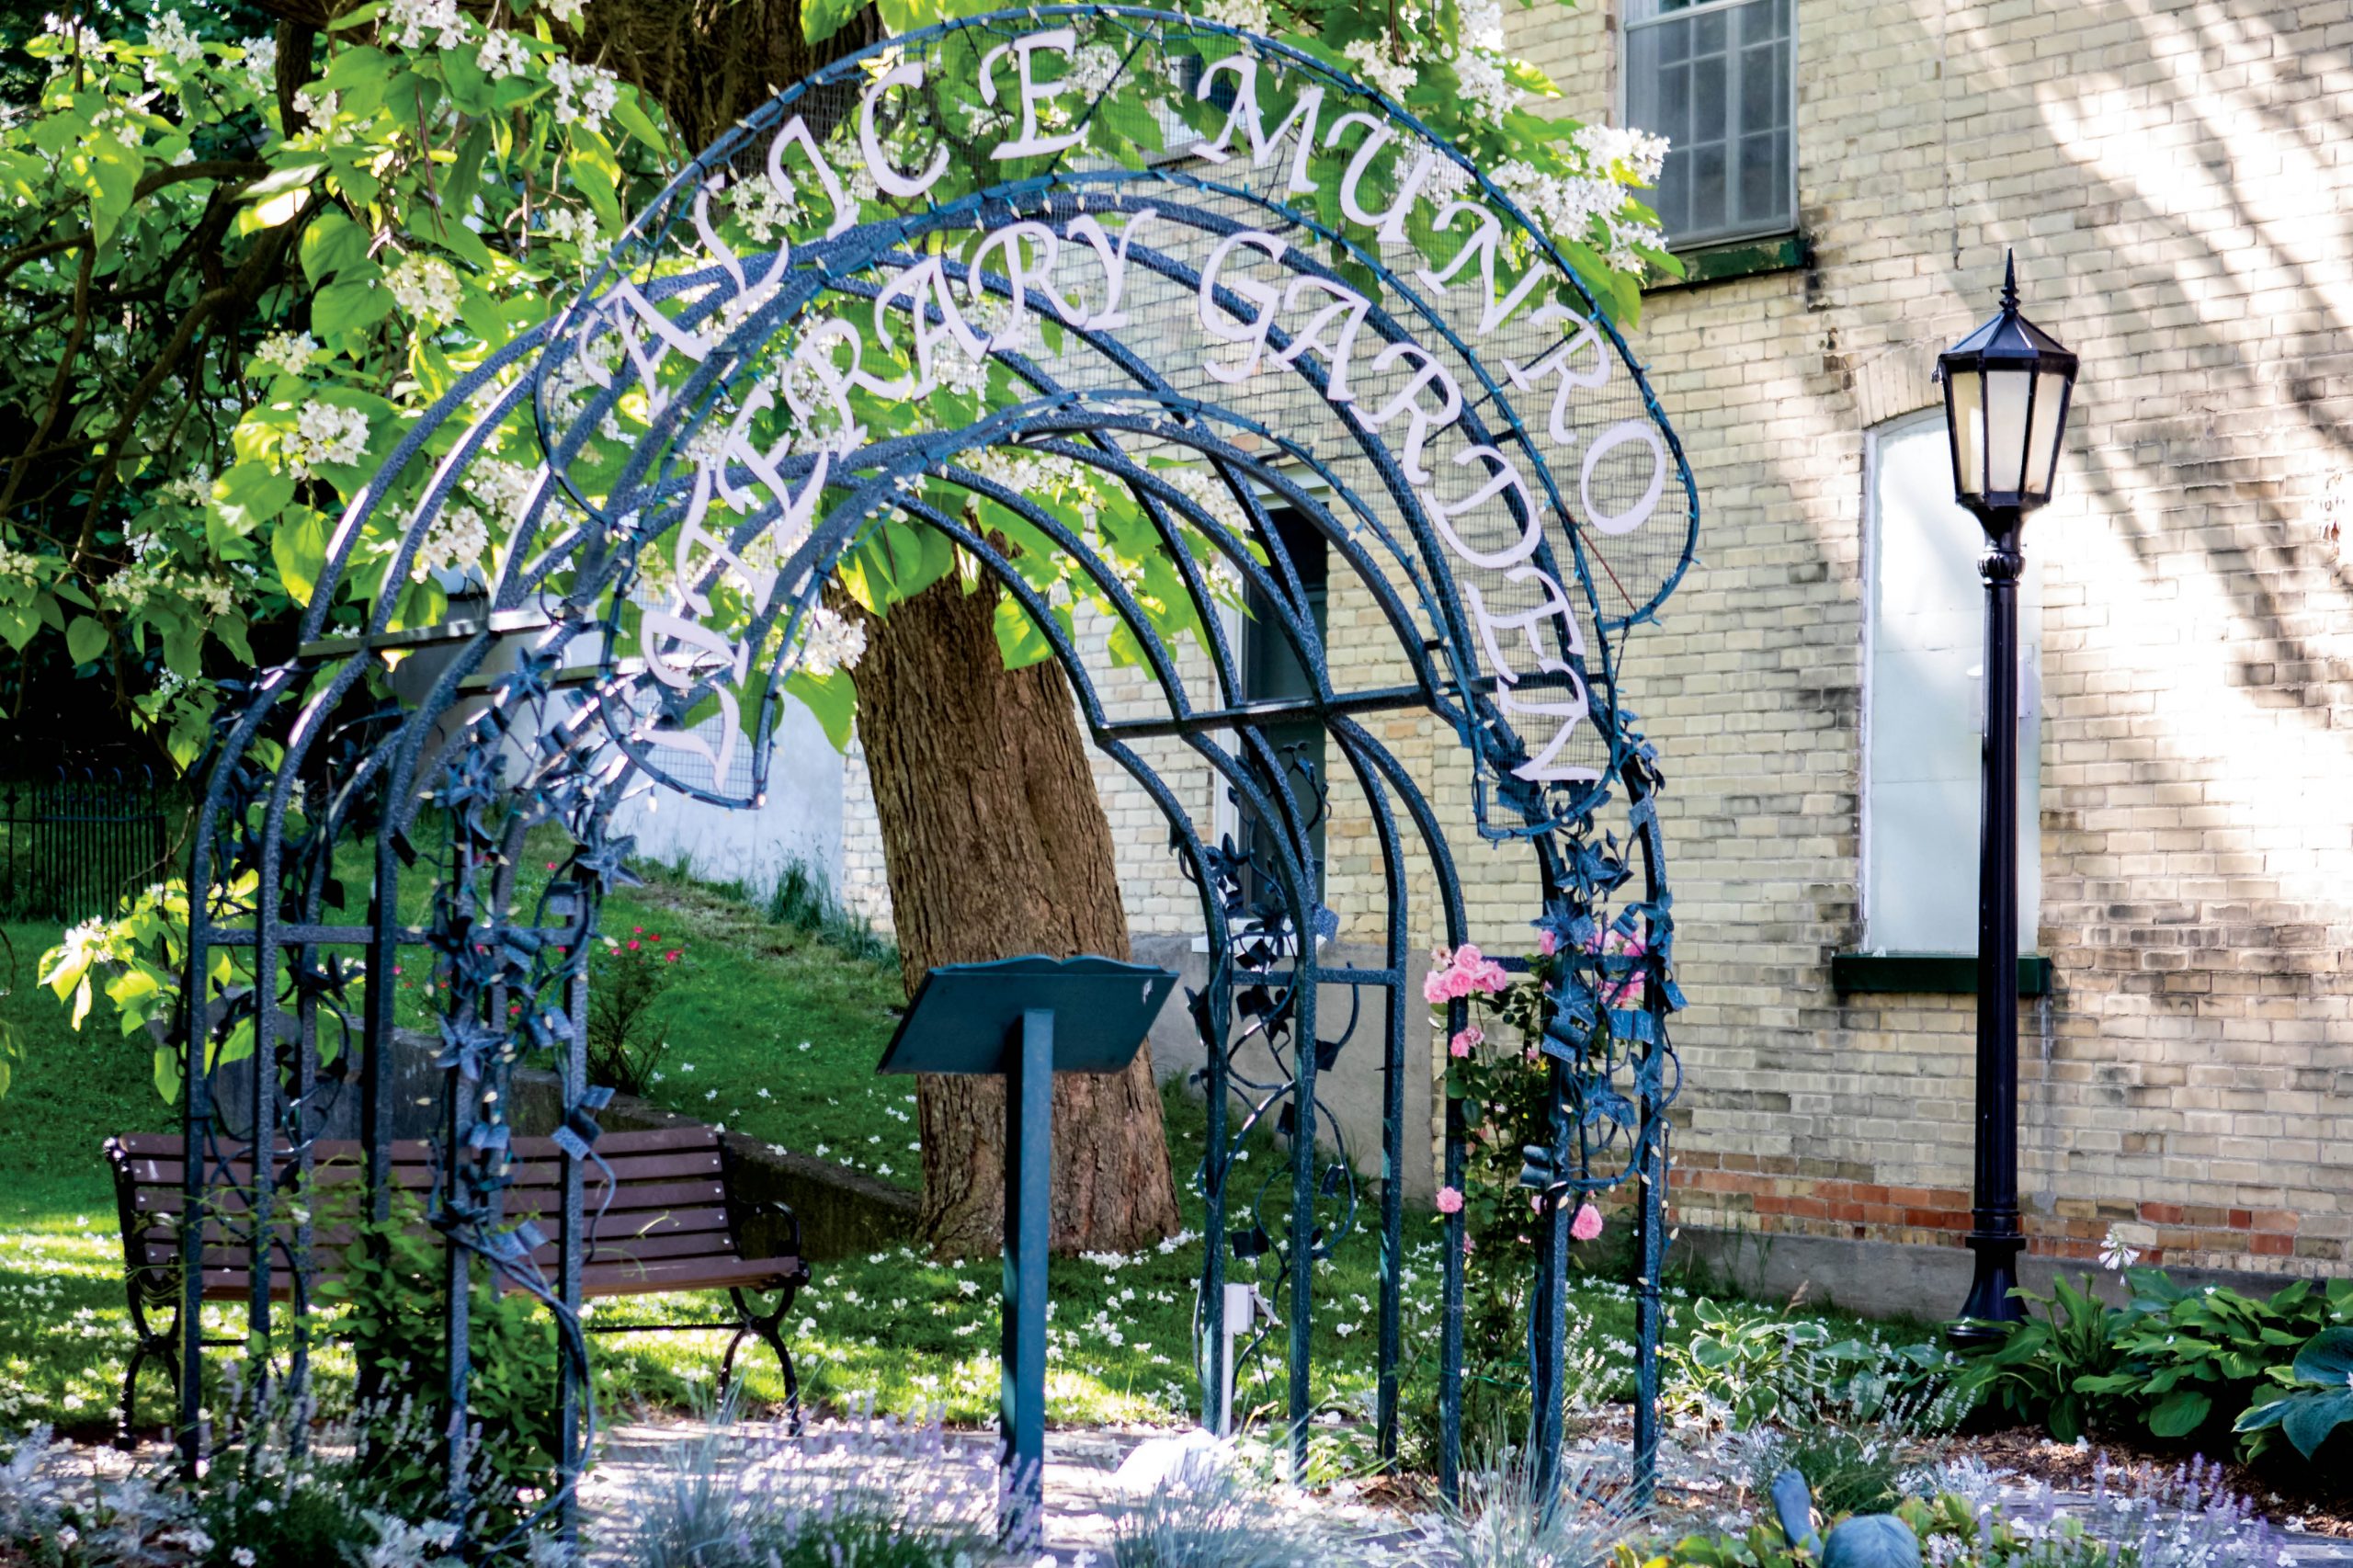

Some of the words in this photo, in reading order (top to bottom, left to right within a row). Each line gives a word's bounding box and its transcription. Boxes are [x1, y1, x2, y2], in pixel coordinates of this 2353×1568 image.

[579, 28, 1090, 420] ALICE
[1191, 54, 1665, 535] MUNRO
[622, 209, 1158, 794] LITERARY
[1199, 231, 1603, 781] GARDEN
